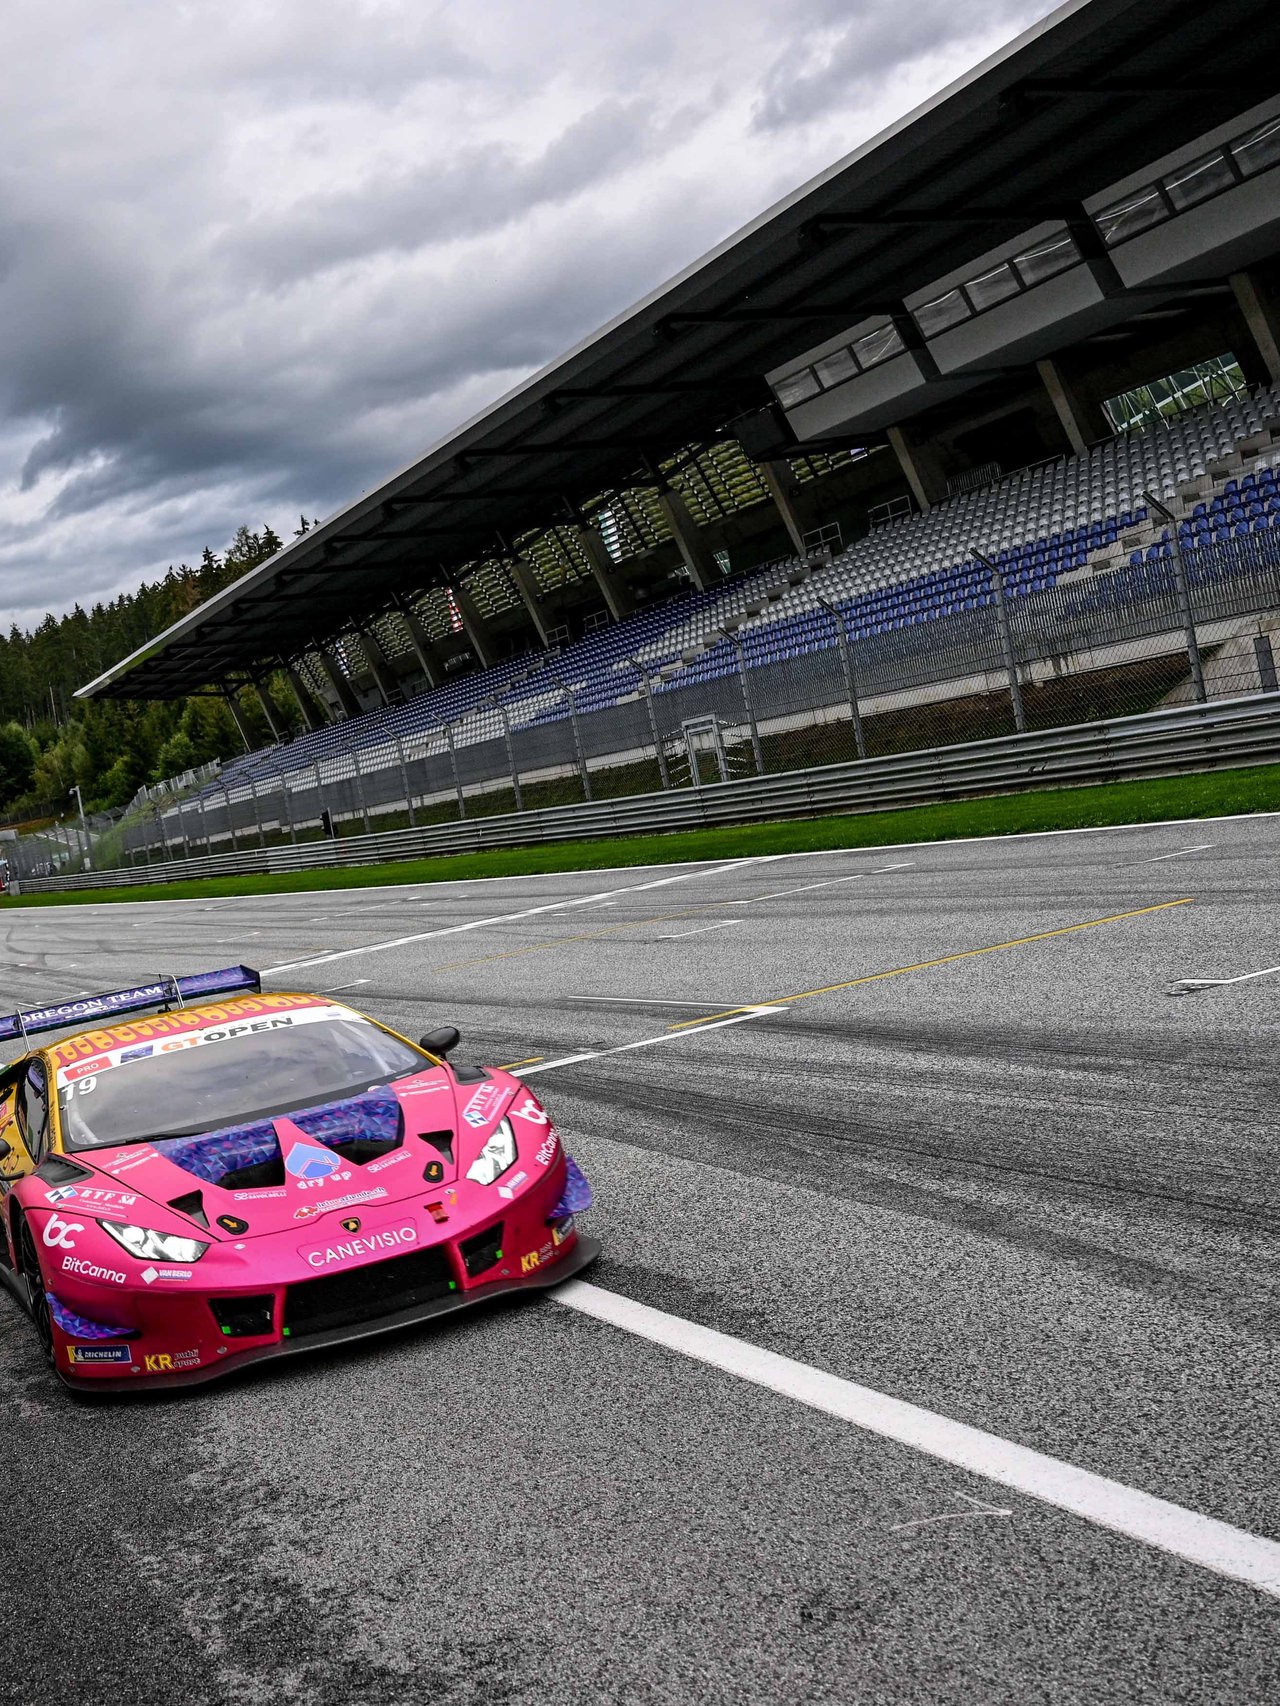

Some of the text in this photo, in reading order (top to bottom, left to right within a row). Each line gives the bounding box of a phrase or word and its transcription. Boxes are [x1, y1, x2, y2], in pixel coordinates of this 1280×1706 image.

[107, 986, 162, 1004] TEAM
[76, 1062, 99, 1075] PRO
[61, 1076, 97, 1101] 19
[297, 1171, 352, 1190] dry up
[308, 1227, 417, 1267] CANEVISIO
[62, 1256, 127, 1284] BitCanna
[521, 1251, 540, 1273] KR
[84, 1350, 122, 1358] MICHELIN
[144, 1353, 175, 1371] KR
